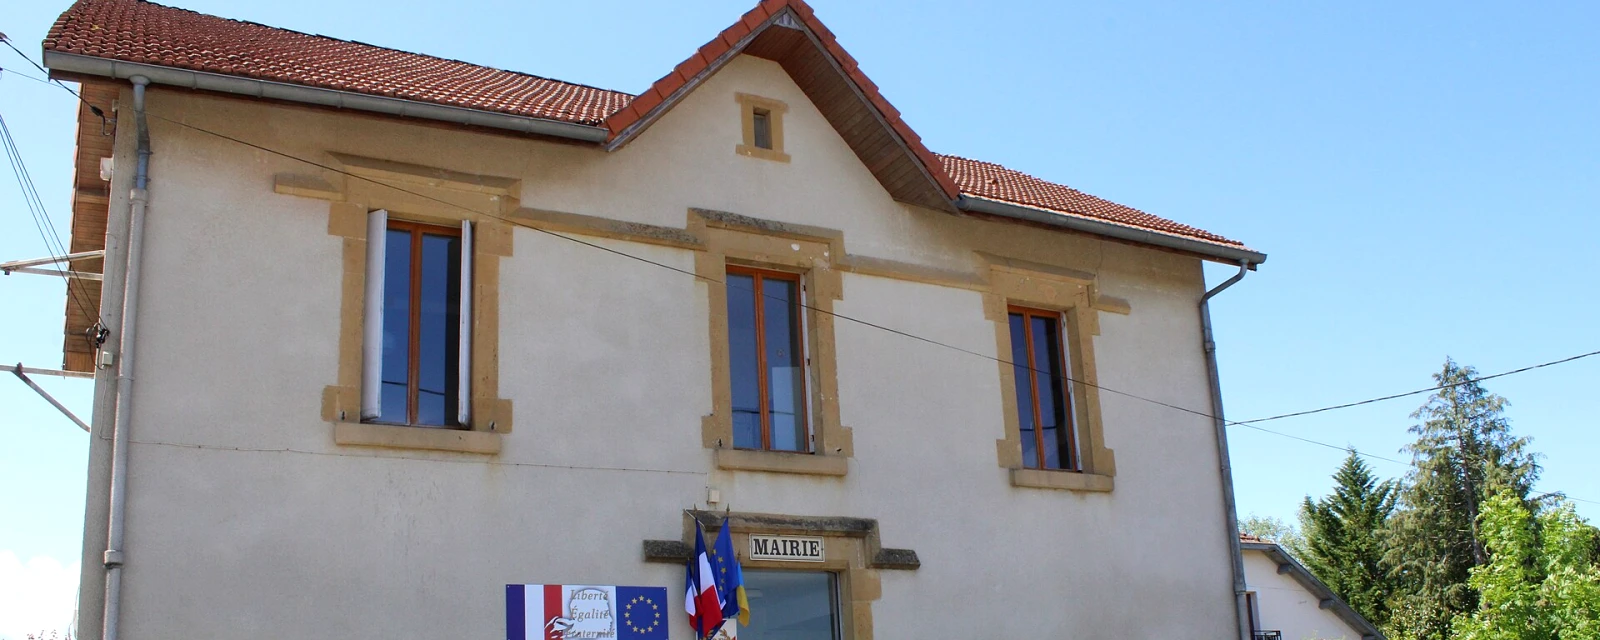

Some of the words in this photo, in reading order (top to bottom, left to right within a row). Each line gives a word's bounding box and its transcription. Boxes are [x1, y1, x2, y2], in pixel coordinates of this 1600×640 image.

[753, 538, 820, 557] MAIRIE
[570, 589, 609, 600] Liberté
[570, 605, 610, 620] Égalité
